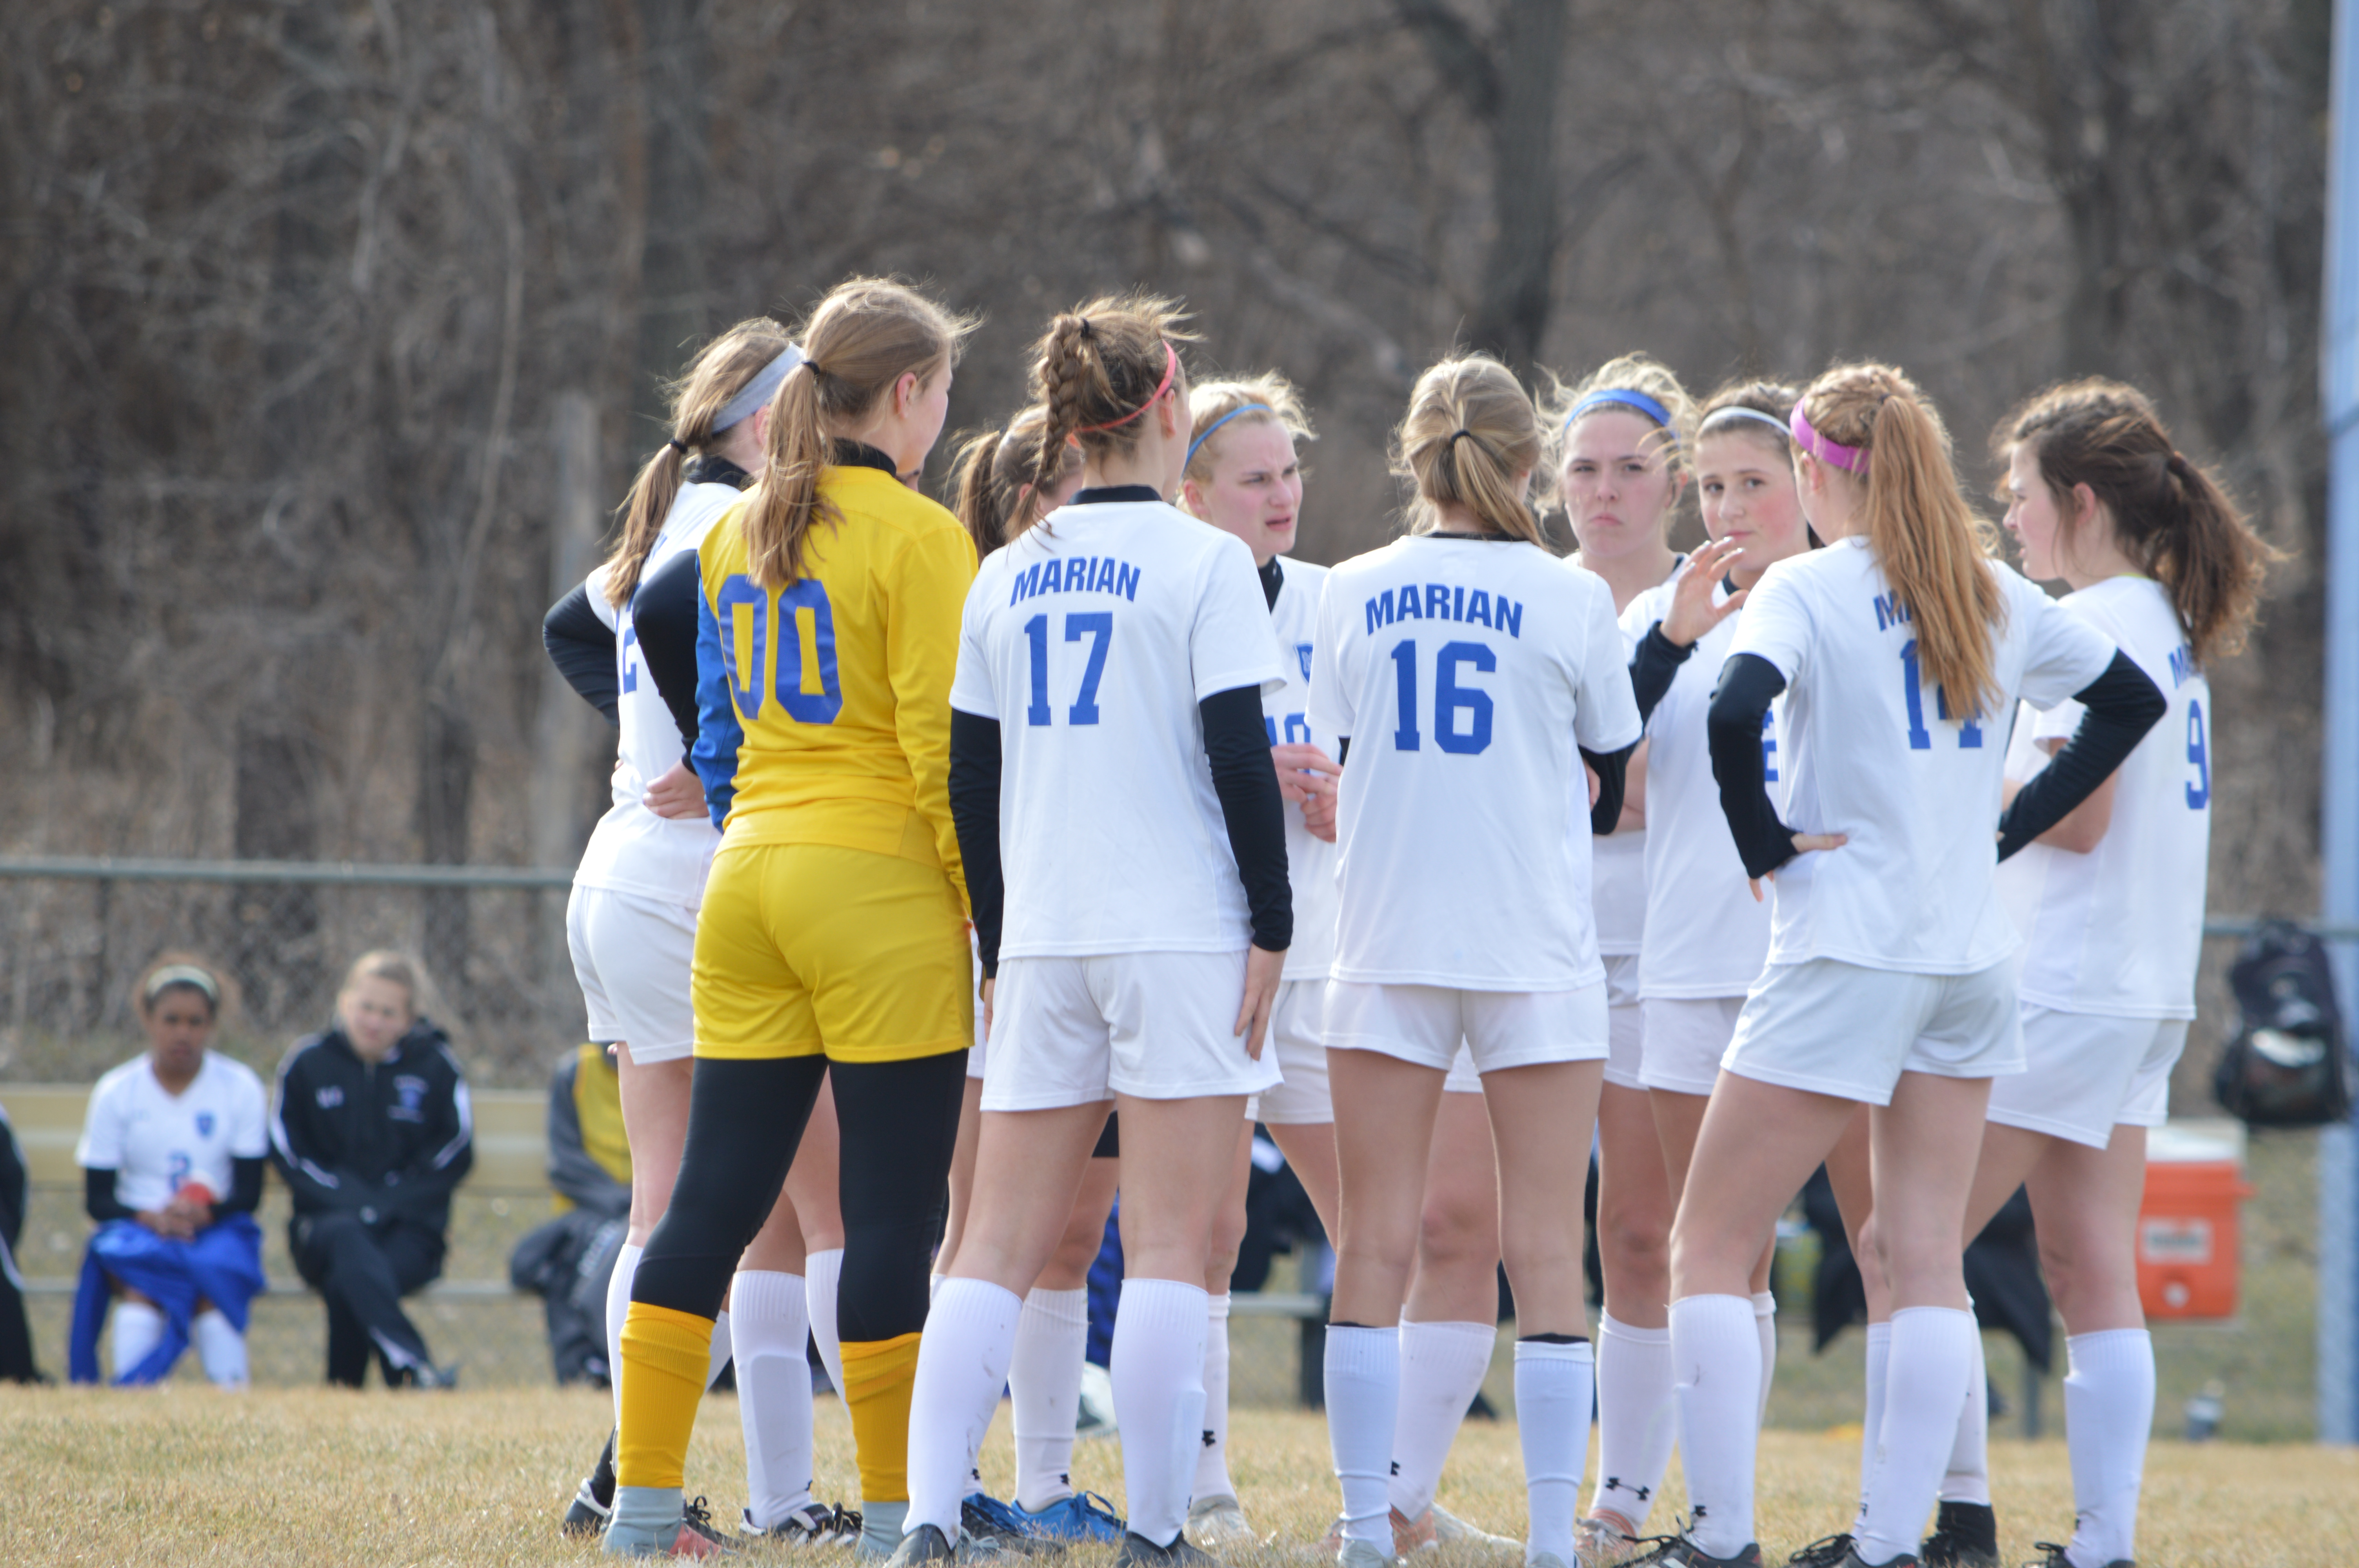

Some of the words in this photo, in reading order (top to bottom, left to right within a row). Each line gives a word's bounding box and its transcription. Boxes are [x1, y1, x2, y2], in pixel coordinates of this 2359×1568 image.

[1010, 557, 1141, 607] MARIAN
[1365, 583, 1523, 639] MARIAN
[717, 574, 843, 724] 00
[1024, 611, 1113, 726] 17
[1391, 639, 1496, 755] 16
[2185, 699, 2209, 809] 9
